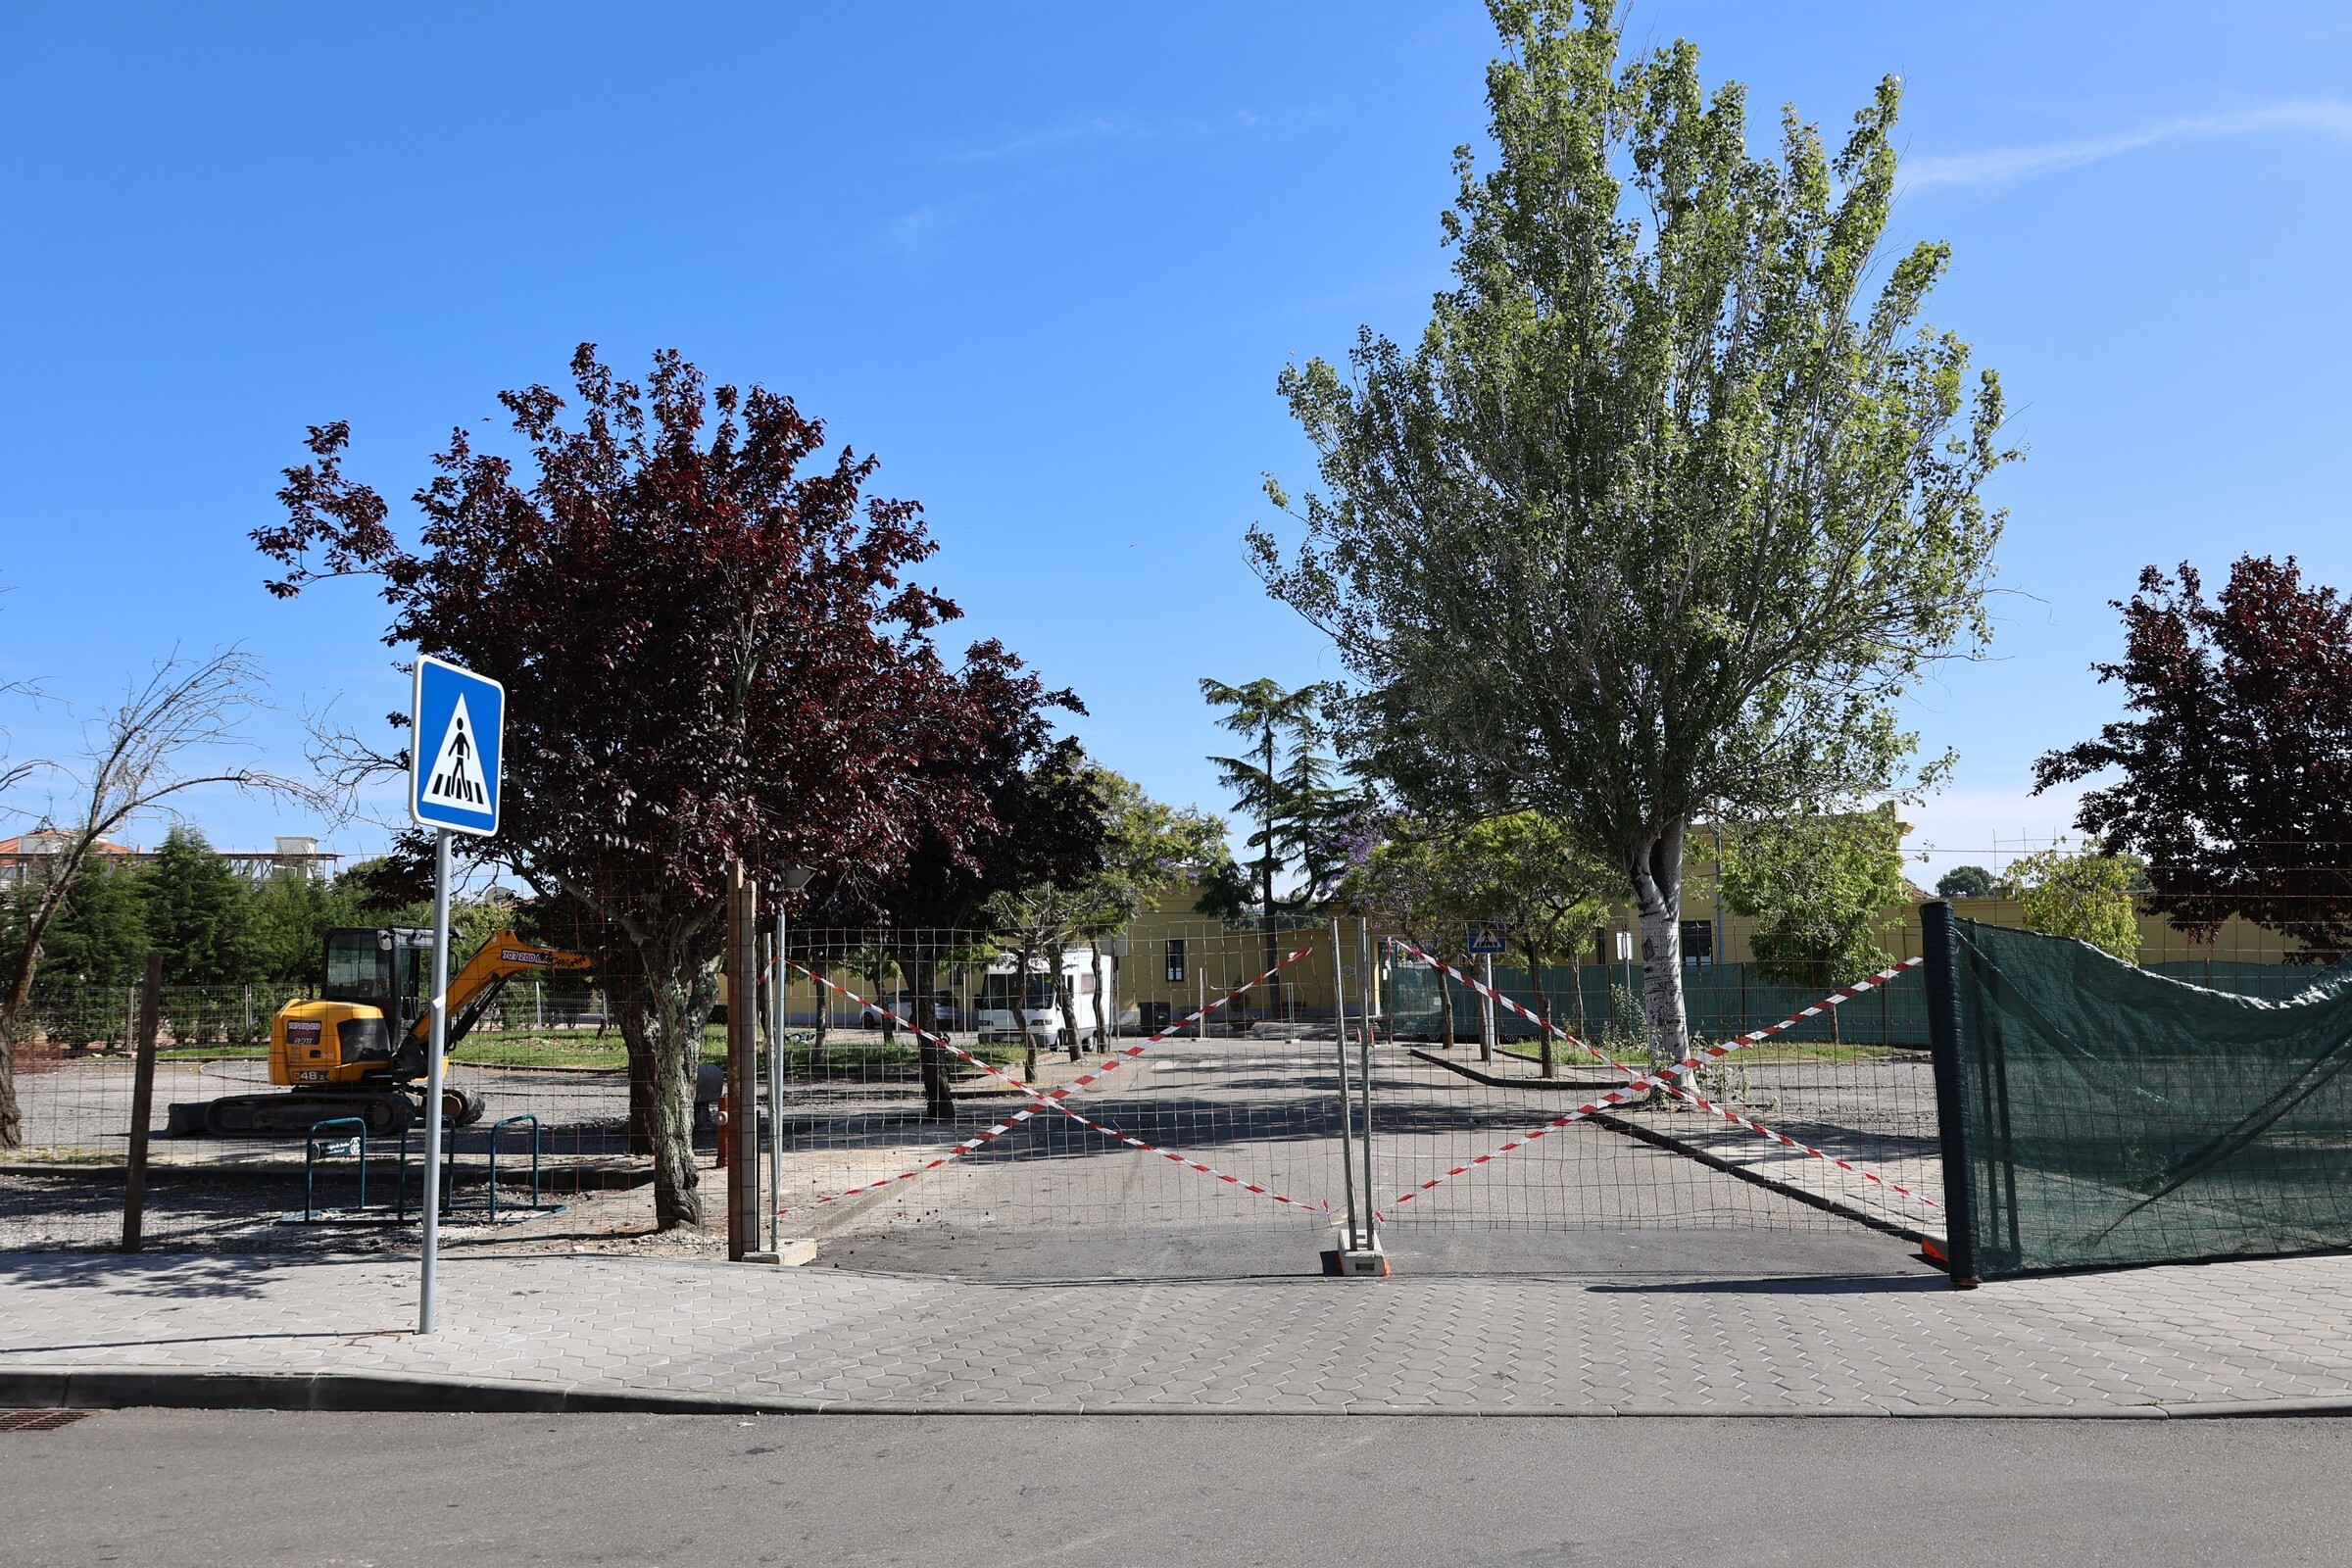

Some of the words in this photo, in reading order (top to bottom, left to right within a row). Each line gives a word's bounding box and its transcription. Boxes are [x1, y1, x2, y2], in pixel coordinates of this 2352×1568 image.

[503, 951, 518, 959] 707
[519, 953, 535, 961] 200
[301, 1071, 317, 1080] 48
